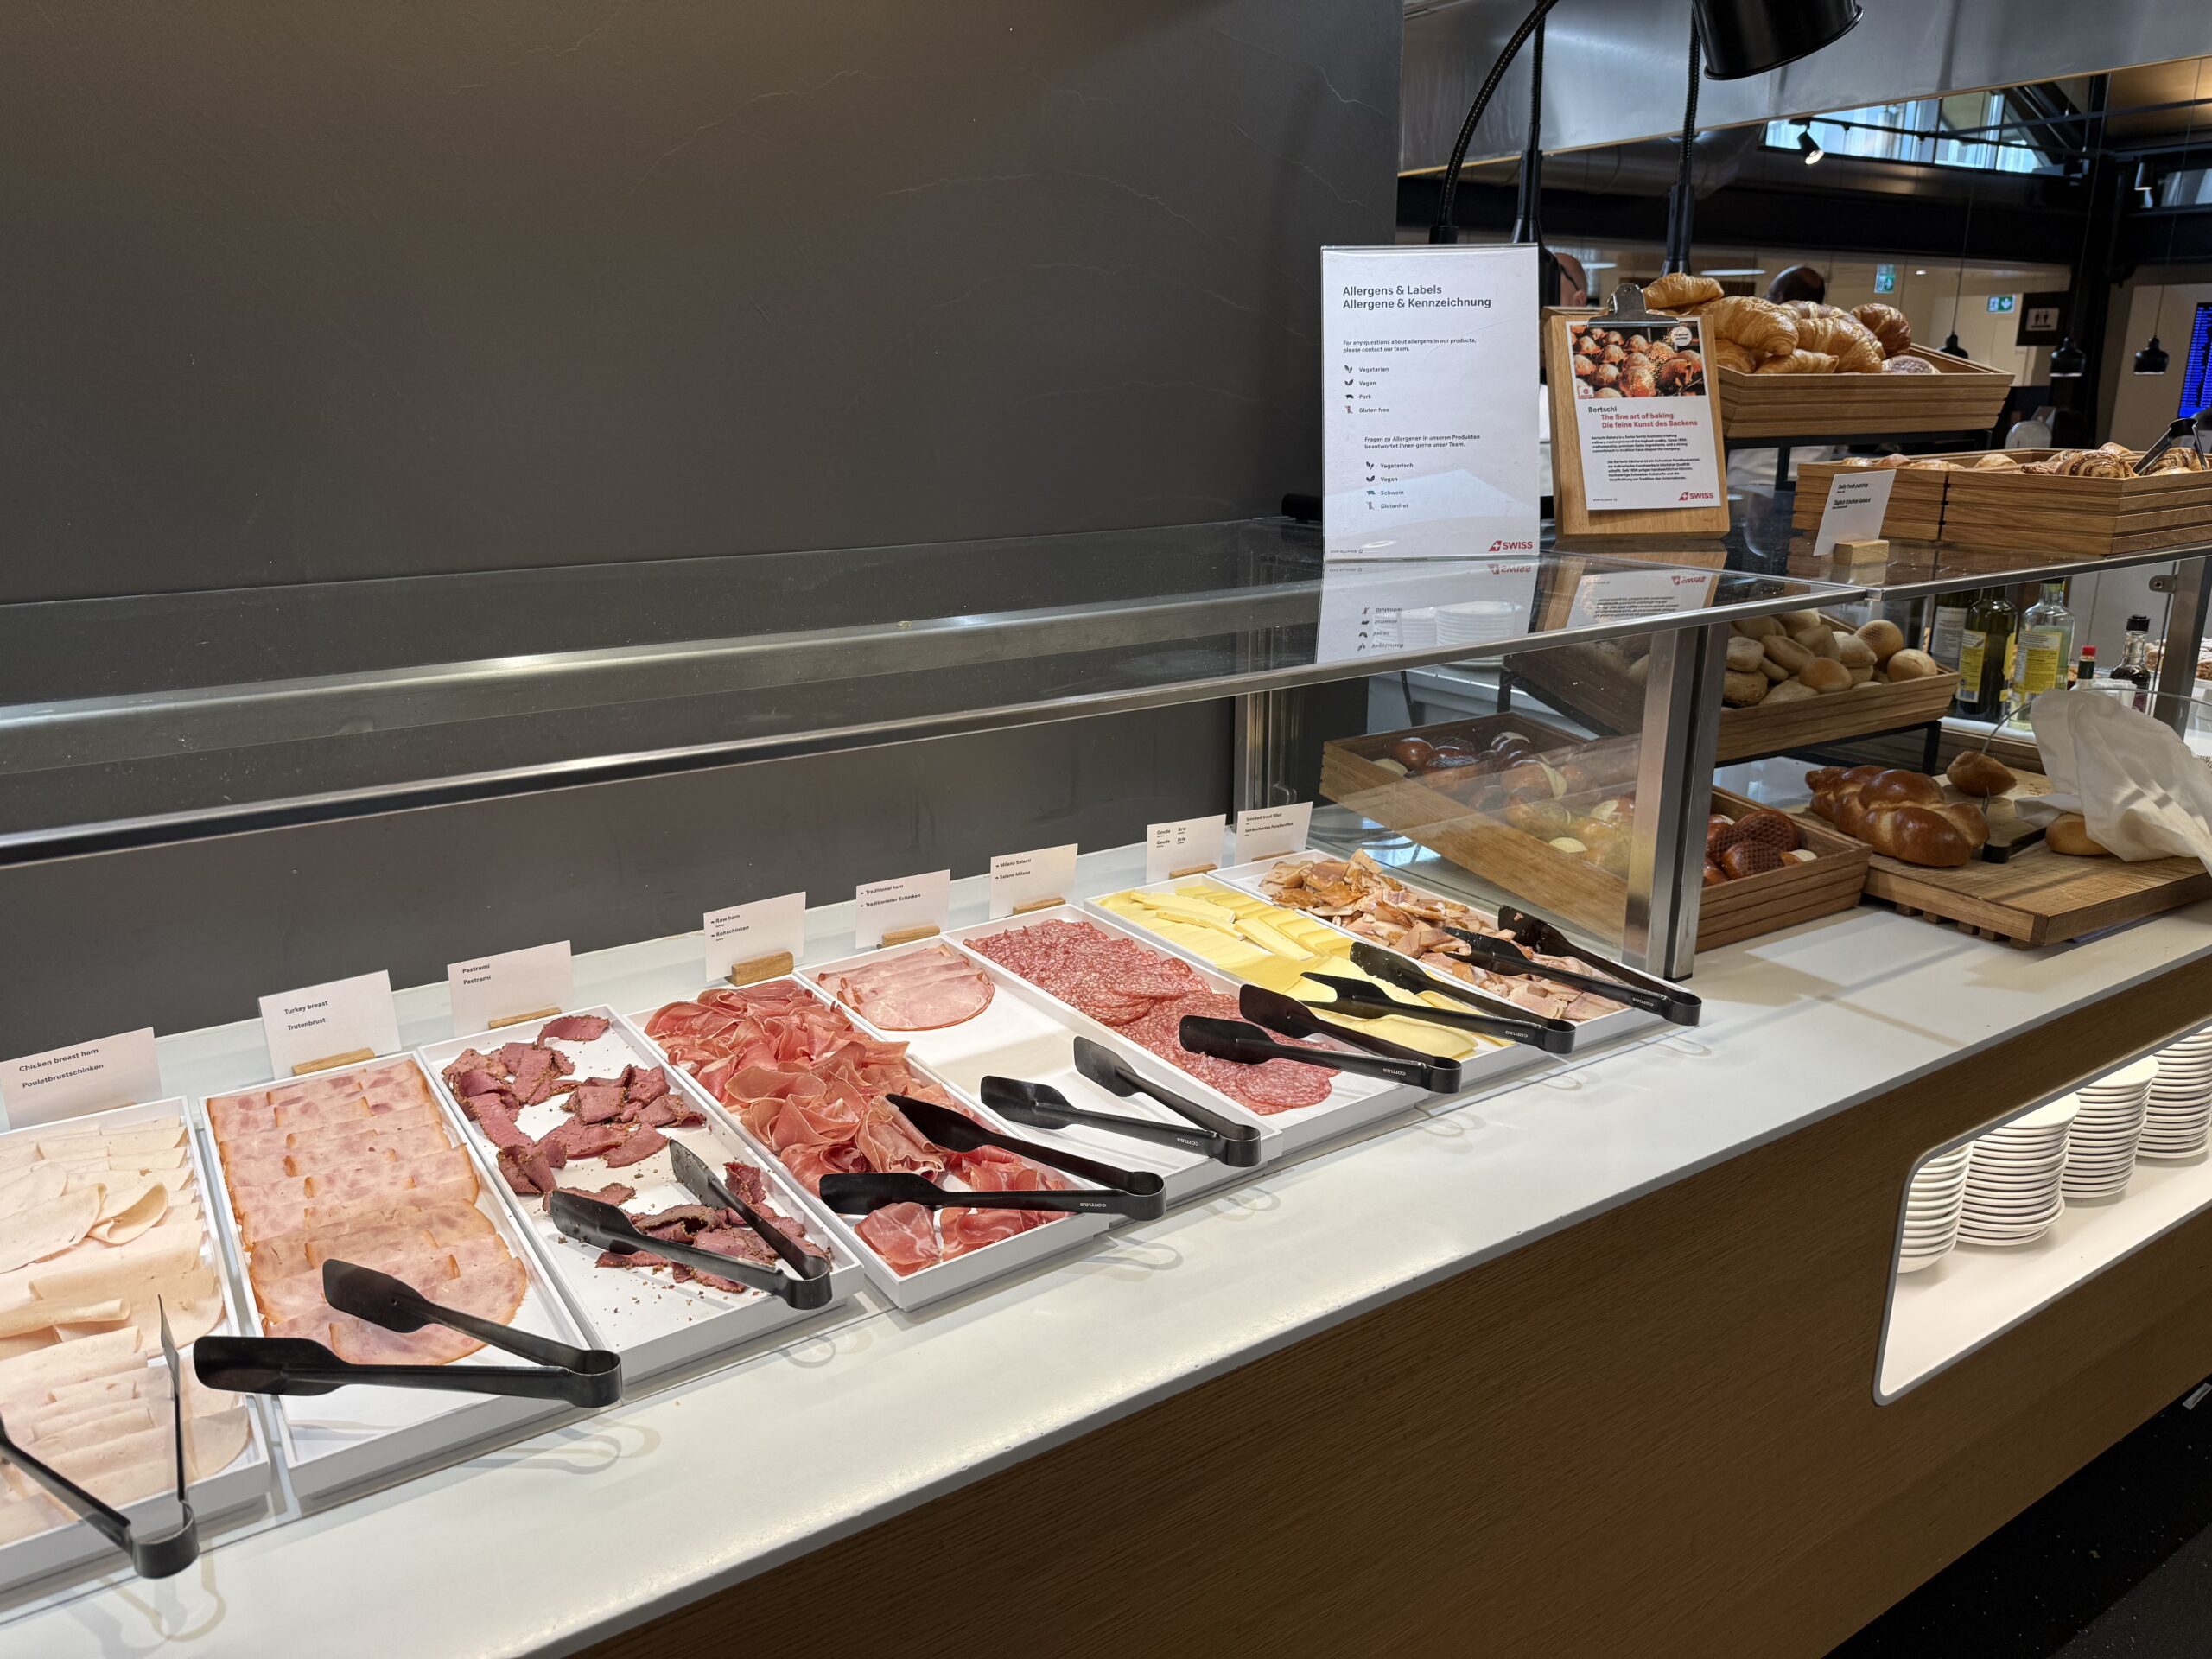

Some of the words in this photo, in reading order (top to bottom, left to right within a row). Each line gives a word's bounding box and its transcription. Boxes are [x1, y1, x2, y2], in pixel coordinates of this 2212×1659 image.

[1343, 286, 1393, 297] Allergens
[1396, 286, 1404, 295] &
[1408, 285, 1442, 295] Labels
[1343, 299, 1394, 310] Allergene
[1397, 299, 1405, 308] &
[1408, 297, 1491, 308] Kennzeichnung
[1503, 542, 1533, 550] SWISS
[866, 886, 892, 894] Traditional
[866, 898, 898, 907] Traditioneller
[716, 925, 749, 937] Rohschinken
[462, 963, 490, 974] Pastrami
[463, 975, 491, 985] Pastrami
[284, 1006, 306, 1015] Turkey
[308, 1001, 328, 1010] breast
[1632, 997, 1654, 1007] comas
[288, 1018, 326, 1031] Trutenbrust
[19, 1059, 52, 1072] Chicken
[54, 1052, 79, 1064] breast
[80, 1048, 99, 1057] ham
[22, 1063, 104, 1089] Pouletbrustschinken
